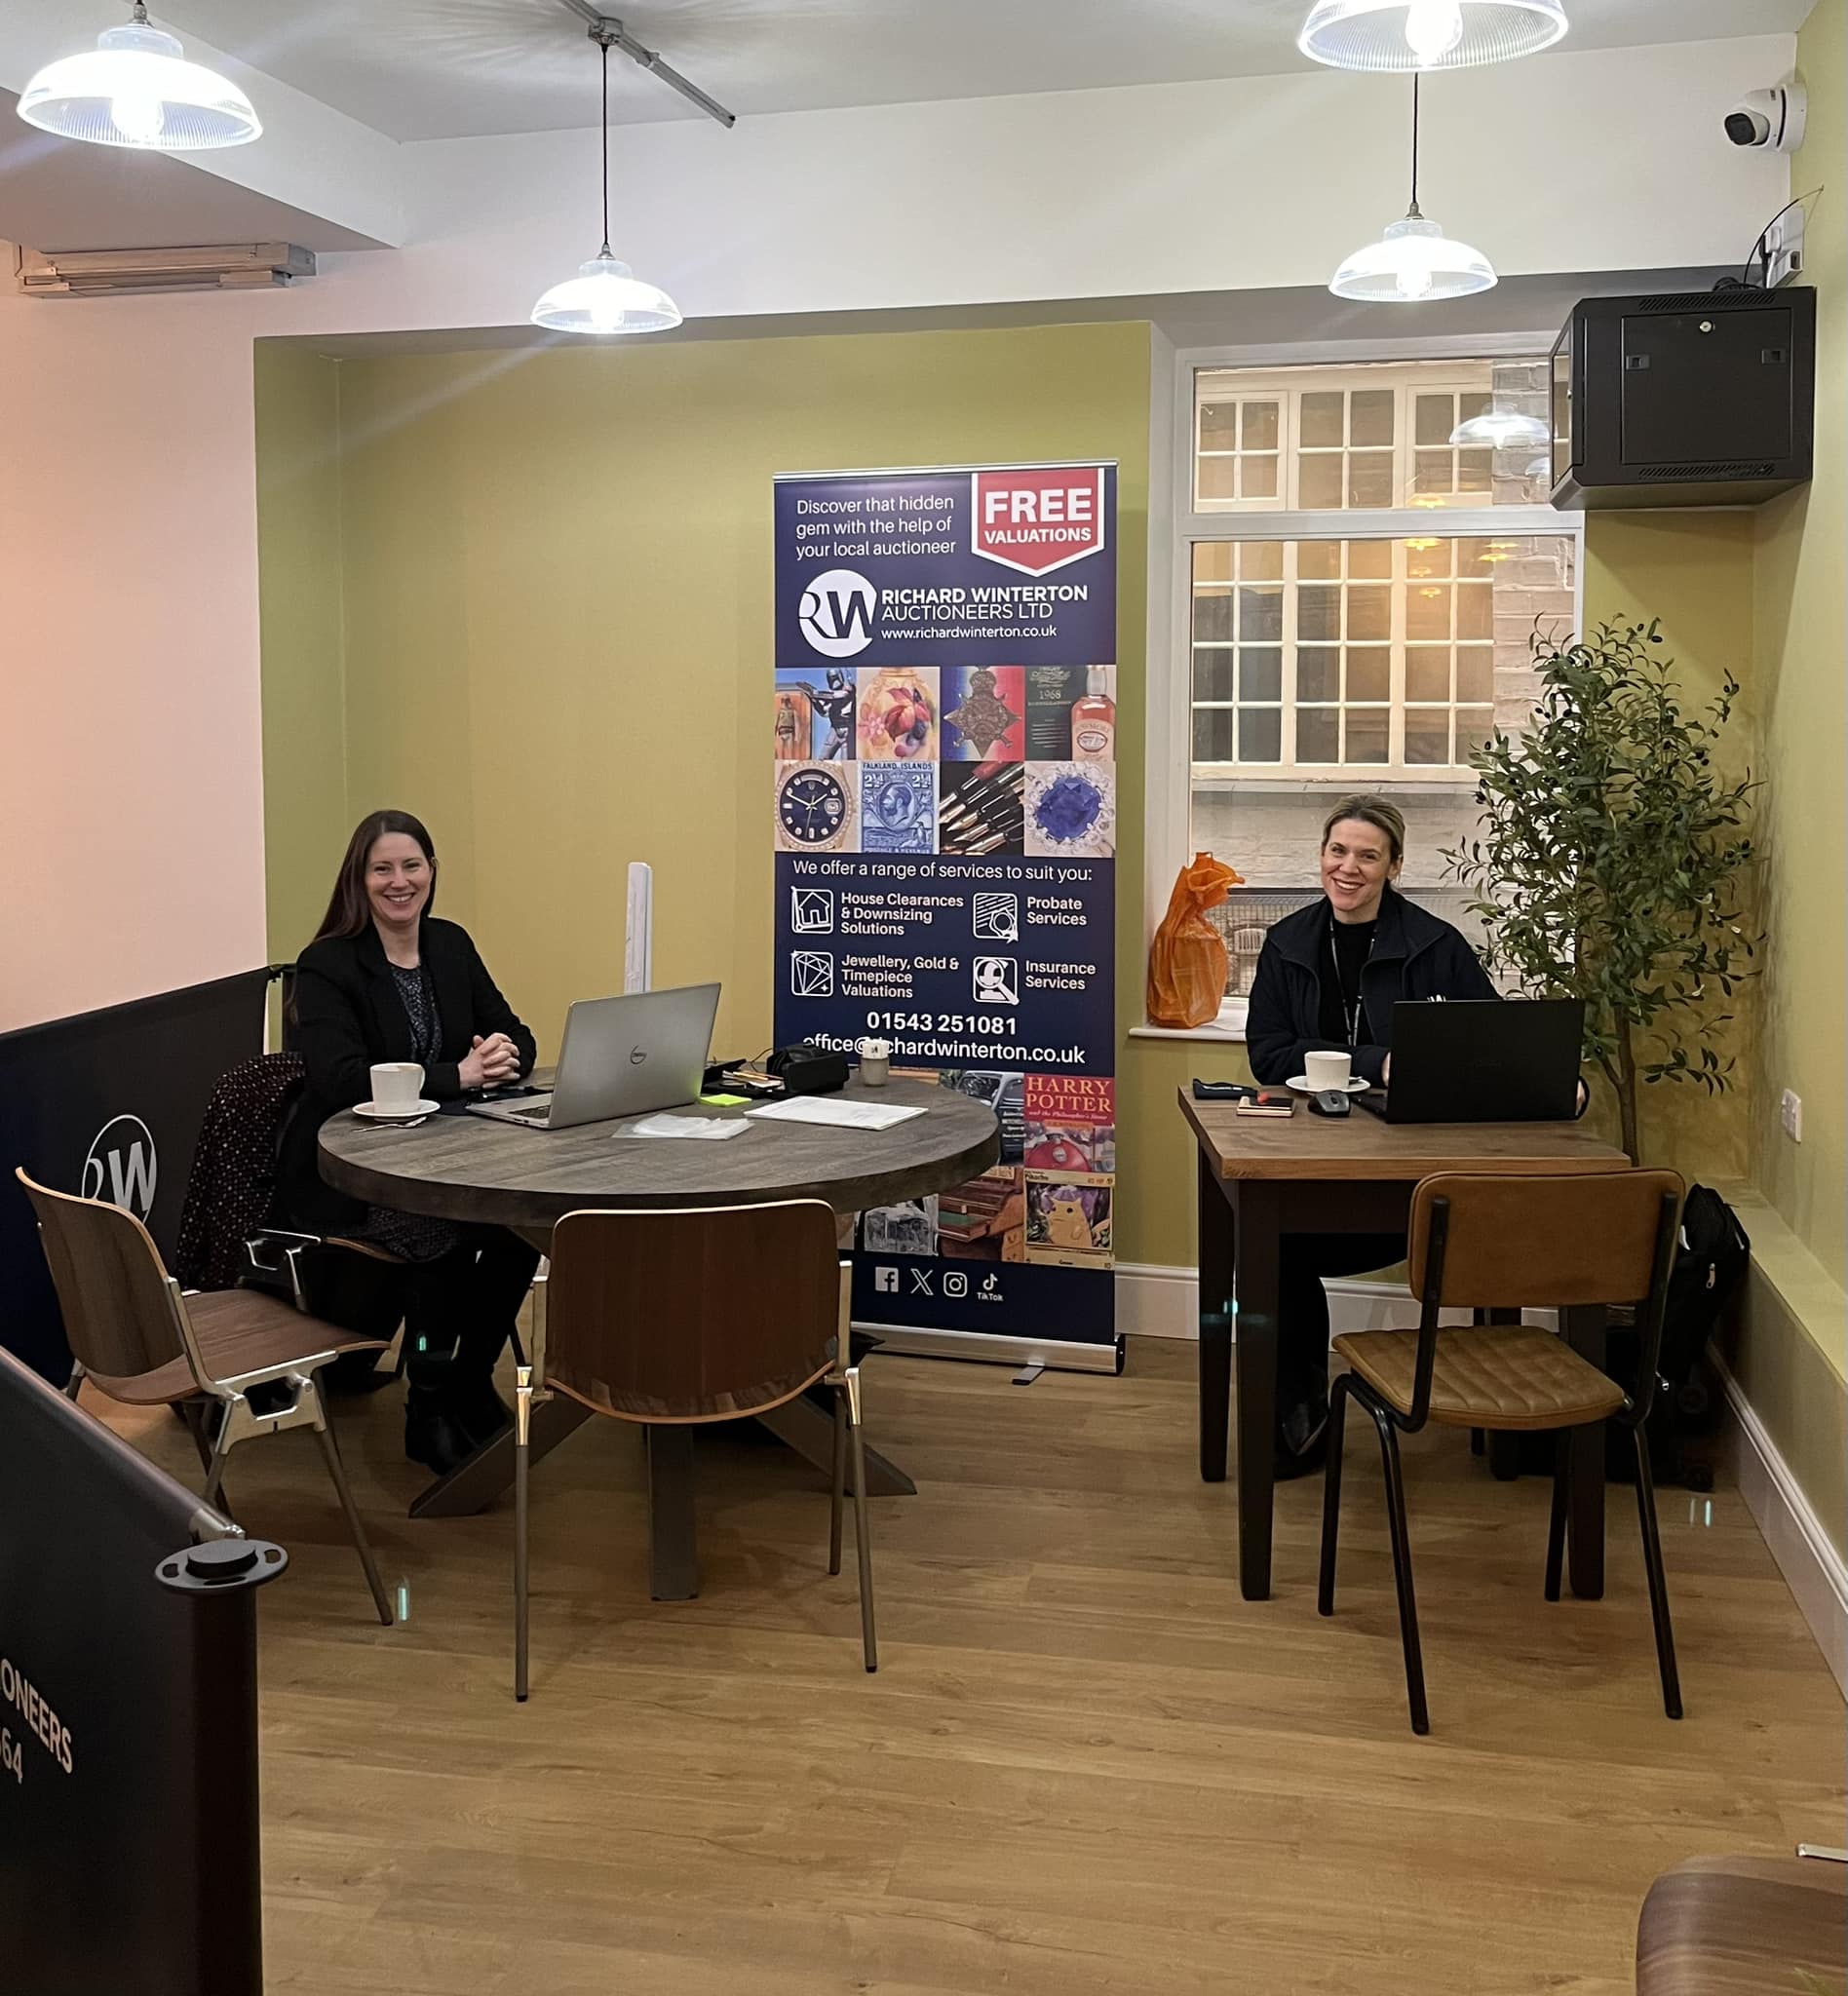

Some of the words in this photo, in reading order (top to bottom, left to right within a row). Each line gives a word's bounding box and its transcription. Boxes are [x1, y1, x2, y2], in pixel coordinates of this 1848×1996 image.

[796, 498, 862, 515] Discover
[866, 498, 896, 512] that
[899, 495, 954, 510] hidden
[984, 487, 1092, 524] FREE
[796, 523, 830, 539] gem
[833, 519, 866, 534] with
[870, 518, 895, 533] the
[898, 518, 933, 534] help
[936, 516, 952, 531] of
[984, 528, 1092, 544] VALUATIONS
[796, 545, 829, 560] your
[833, 541, 869, 556] local
[873, 541, 955, 555] auctioneer
[881, 588, 966, 605] RICHARD
[971, 585, 1088, 602] WINTERTON
[881, 604, 1014, 621] AUCTIONEERS
[1018, 603, 1053, 619] LTD
[881, 626, 1058, 640] www.richardwinterton.co.uk
[793, 861, 817, 874] We
[821, 860, 855, 875] offer
[859, 864, 867, 875] a
[872, 864, 916, 879] range
[920, 863, 936, 876] of
[939, 864, 1002, 878] services
[1007, 866, 1021, 878] to
[1025, 865, 1054, 880] suit
[1058, 868, 1093, 883] you:
[841, 893, 884, 904] House
[887, 894, 964, 906] Clearances
[1027, 897, 1082, 909] Probate
[841, 908, 850, 919] &
[854, 908, 933, 924] Downsizing
[1027, 912, 1087, 925] Services
[841, 923, 905, 935] Solutions
[842, 955, 910, 970] Jewellery,
[913, 957, 945, 969] Gold
[949, 958, 959, 969] &
[1025, 961, 1096, 975] Insurance
[842, 970, 912, 983] Timepiece
[1025, 977, 1085, 989] Services
[842, 984, 912, 998] Valuations
[866, 1012, 933, 1031] 01543
[939, 1016, 1017, 1035] 251081
[1028, 1077, 1110, 1094] HARRY
[1027, 1094, 1111, 1112] POTTER
[977, 1291, 1003, 1302] TikTok
[0, 1659, 72, 1773] ONEERS
[0, 1727, 22, 1785] 64
